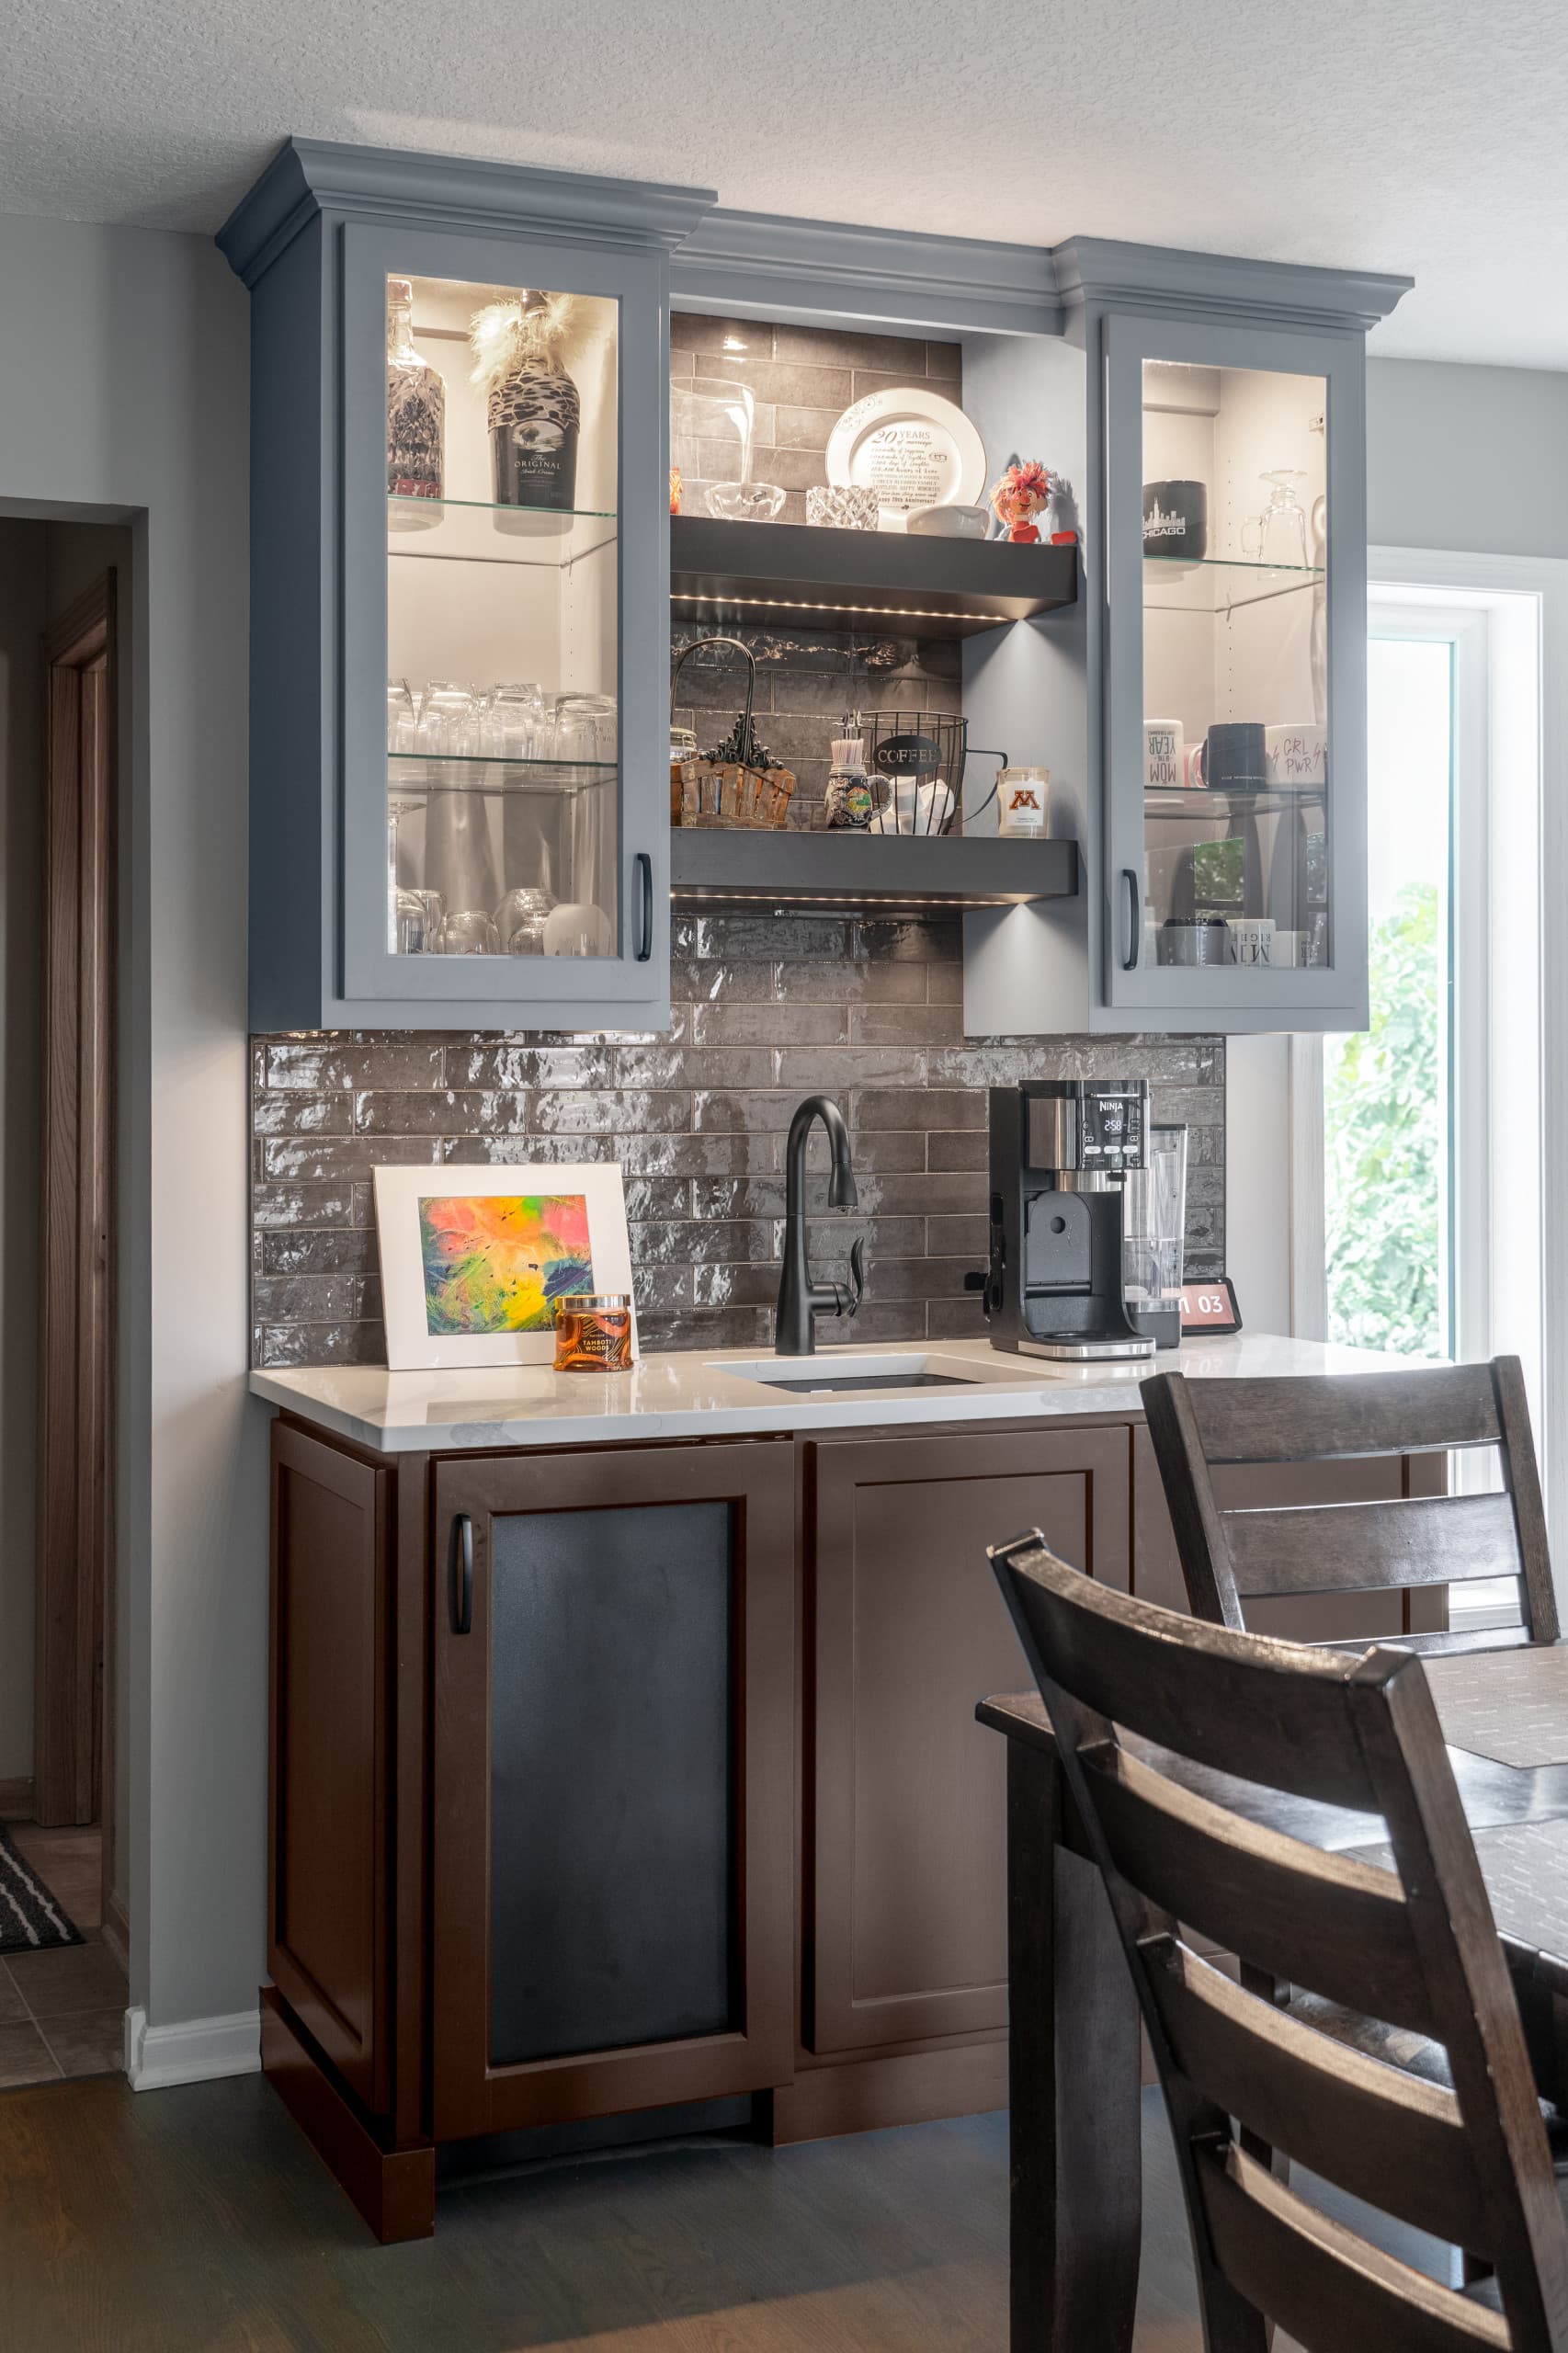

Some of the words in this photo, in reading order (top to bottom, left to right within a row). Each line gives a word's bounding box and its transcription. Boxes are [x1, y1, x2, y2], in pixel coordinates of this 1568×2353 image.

[871, 430, 898, 444] 20
[901, 430, 931, 439] YEARS
[514, 460, 562, 470] ORIGINAL
[1149, 736, 1176, 755] YEAR
[1284, 737, 1309, 756] GRL
[878, 749, 937, 764] COFFEE
[1287, 756, 1312, 775] PWR
[1150, 763, 1176, 782] MOM
[1008, 790, 1041, 811] M
[1198, 1295, 1223, 1313] 03
